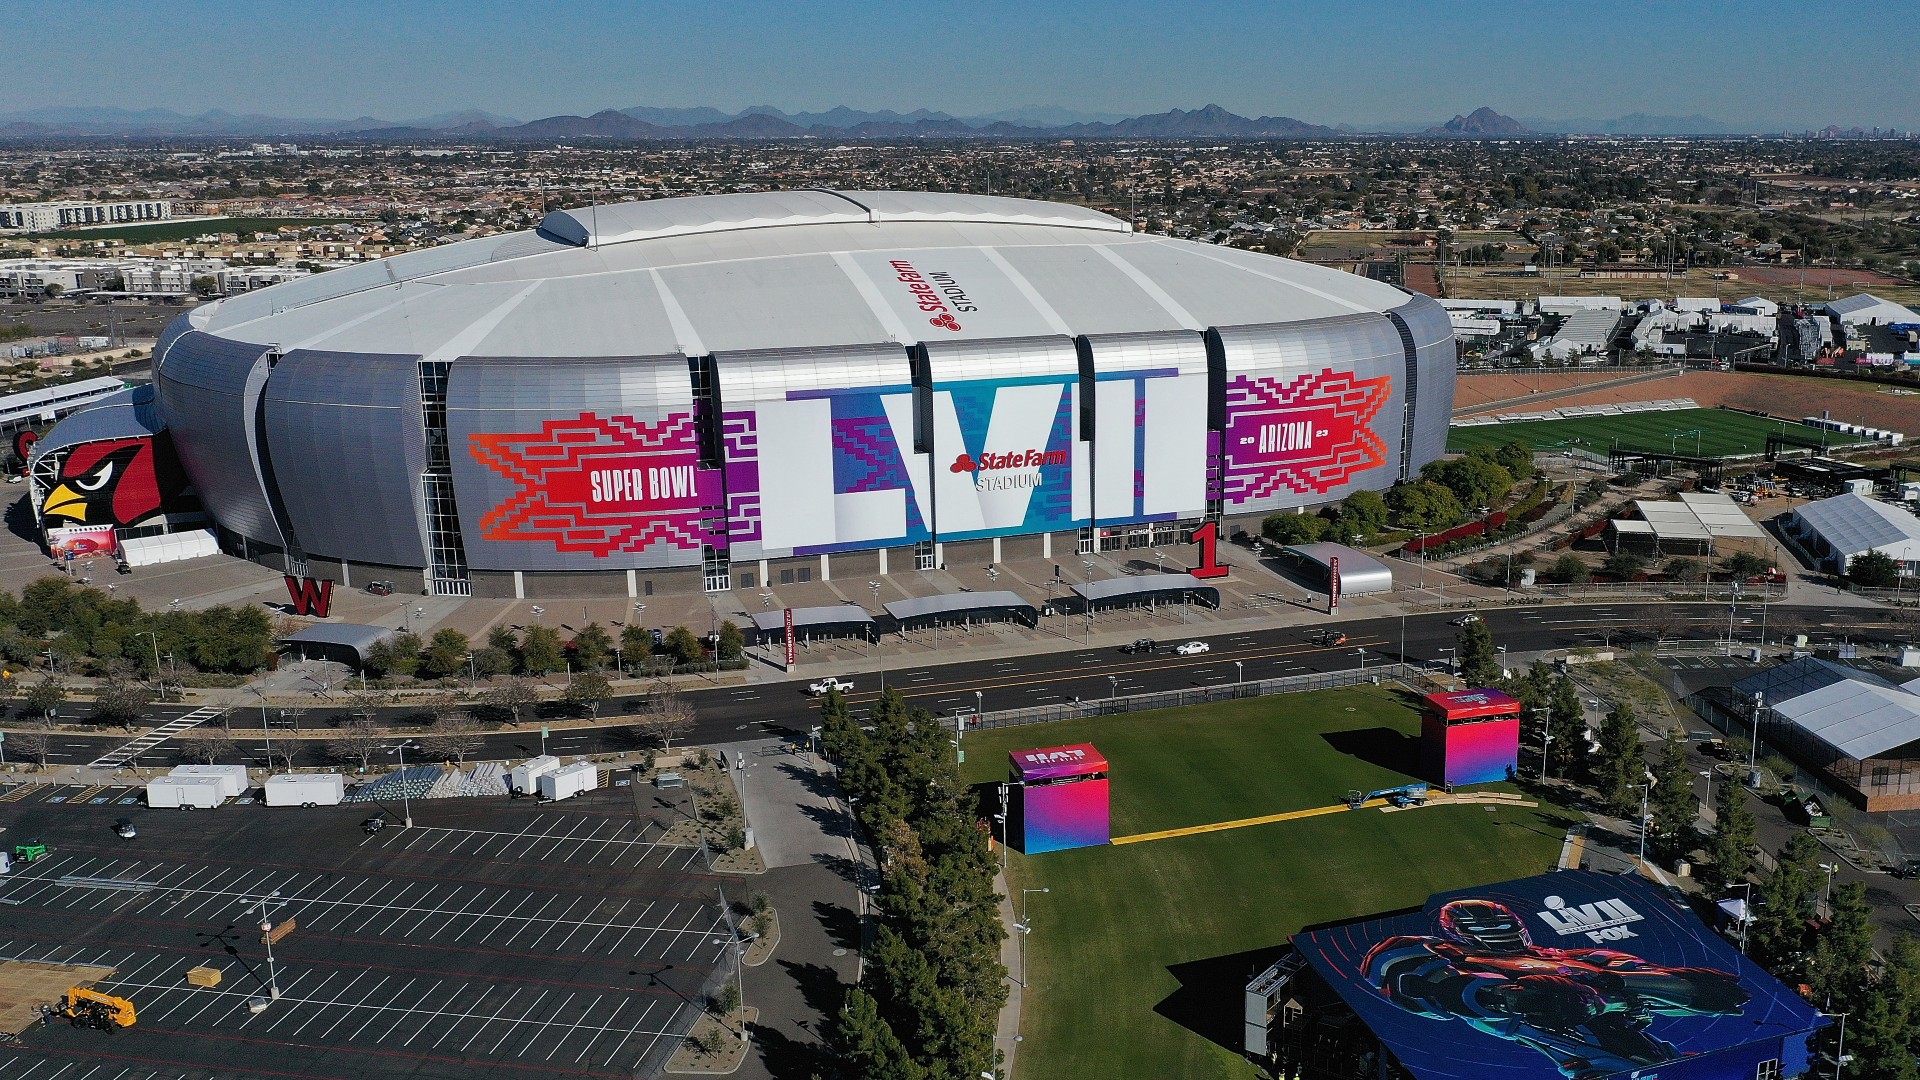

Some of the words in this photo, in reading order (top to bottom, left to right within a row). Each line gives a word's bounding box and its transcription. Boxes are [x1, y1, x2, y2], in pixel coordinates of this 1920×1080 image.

[928, 271, 978, 312] STADIUM
[1239, 436, 1255, 445] 20
[1258, 420, 1312, 454] ARIZONA
[1315, 429, 1329, 438] 23
[755, 372, 1208, 550] LVII
[590, 468, 643, 503] SUPER
[649, 465, 698, 500] BOWL
[976, 473, 1042, 492] STADIUM
[1186, 521, 1230, 580] 1
[283, 575, 335, 618] W
[1536, 898, 1639, 931] LVII
[1585, 925, 1639, 944] FOX
